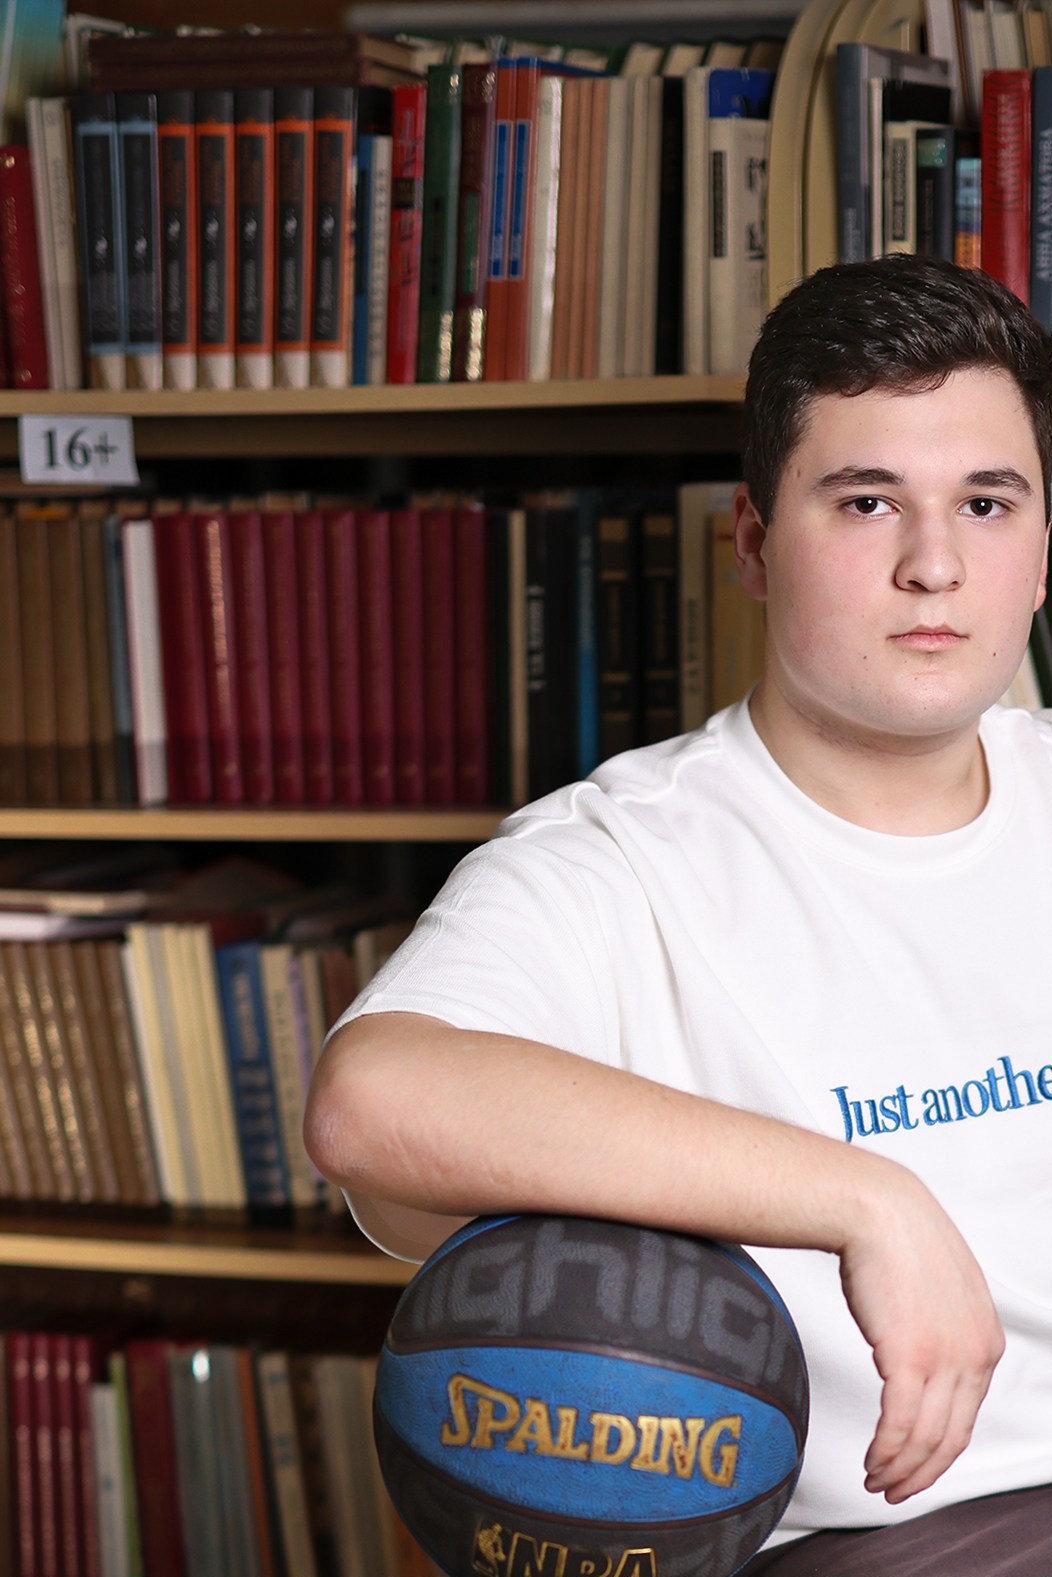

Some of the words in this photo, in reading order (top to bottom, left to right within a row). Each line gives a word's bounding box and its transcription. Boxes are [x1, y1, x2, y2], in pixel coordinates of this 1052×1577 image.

[1036, 230, 1052, 281] АННА
[42, 427, 119, 472] 16+
[831, 1085, 920, 1142] Just
[440, 1373, 742, 1488] SPALDING
